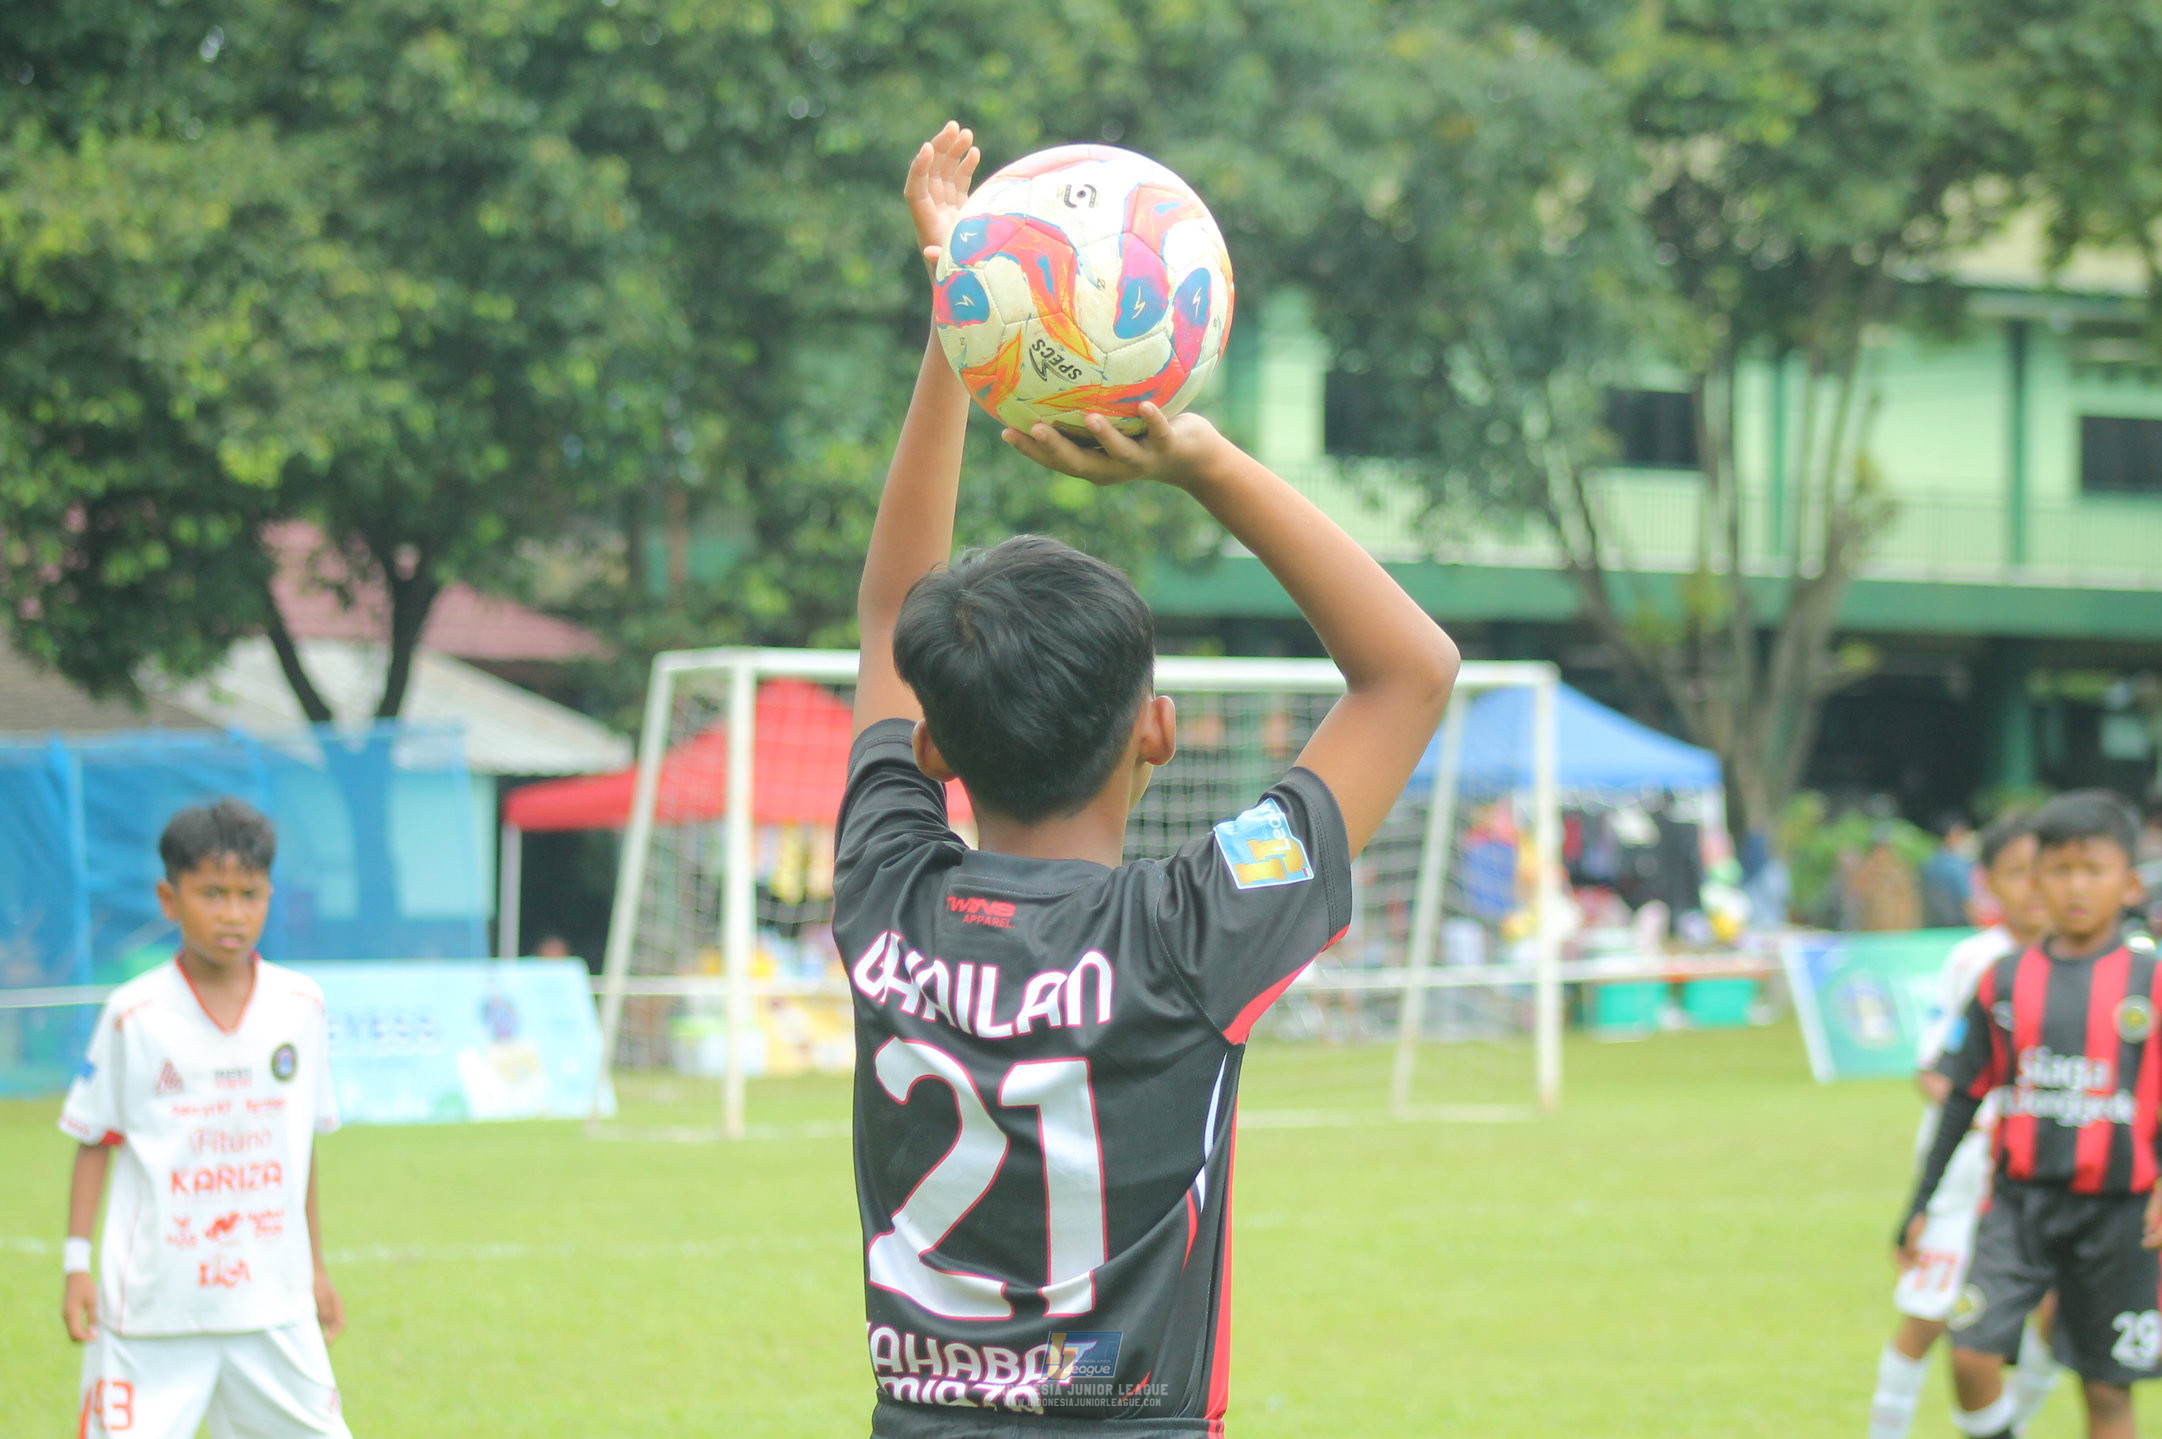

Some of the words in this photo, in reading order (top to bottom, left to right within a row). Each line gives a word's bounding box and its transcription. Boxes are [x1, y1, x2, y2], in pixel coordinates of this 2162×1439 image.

[1031, 338, 1083, 380] SPECS
[946, 896, 1016, 918] TWINS
[170, 1161, 282, 1195] KARIZA
[868, 1035, 1109, 1321] 21
[866, 1321, 1098, 1387] AHABAT
[2110, 1309, 2162, 1366] 29
